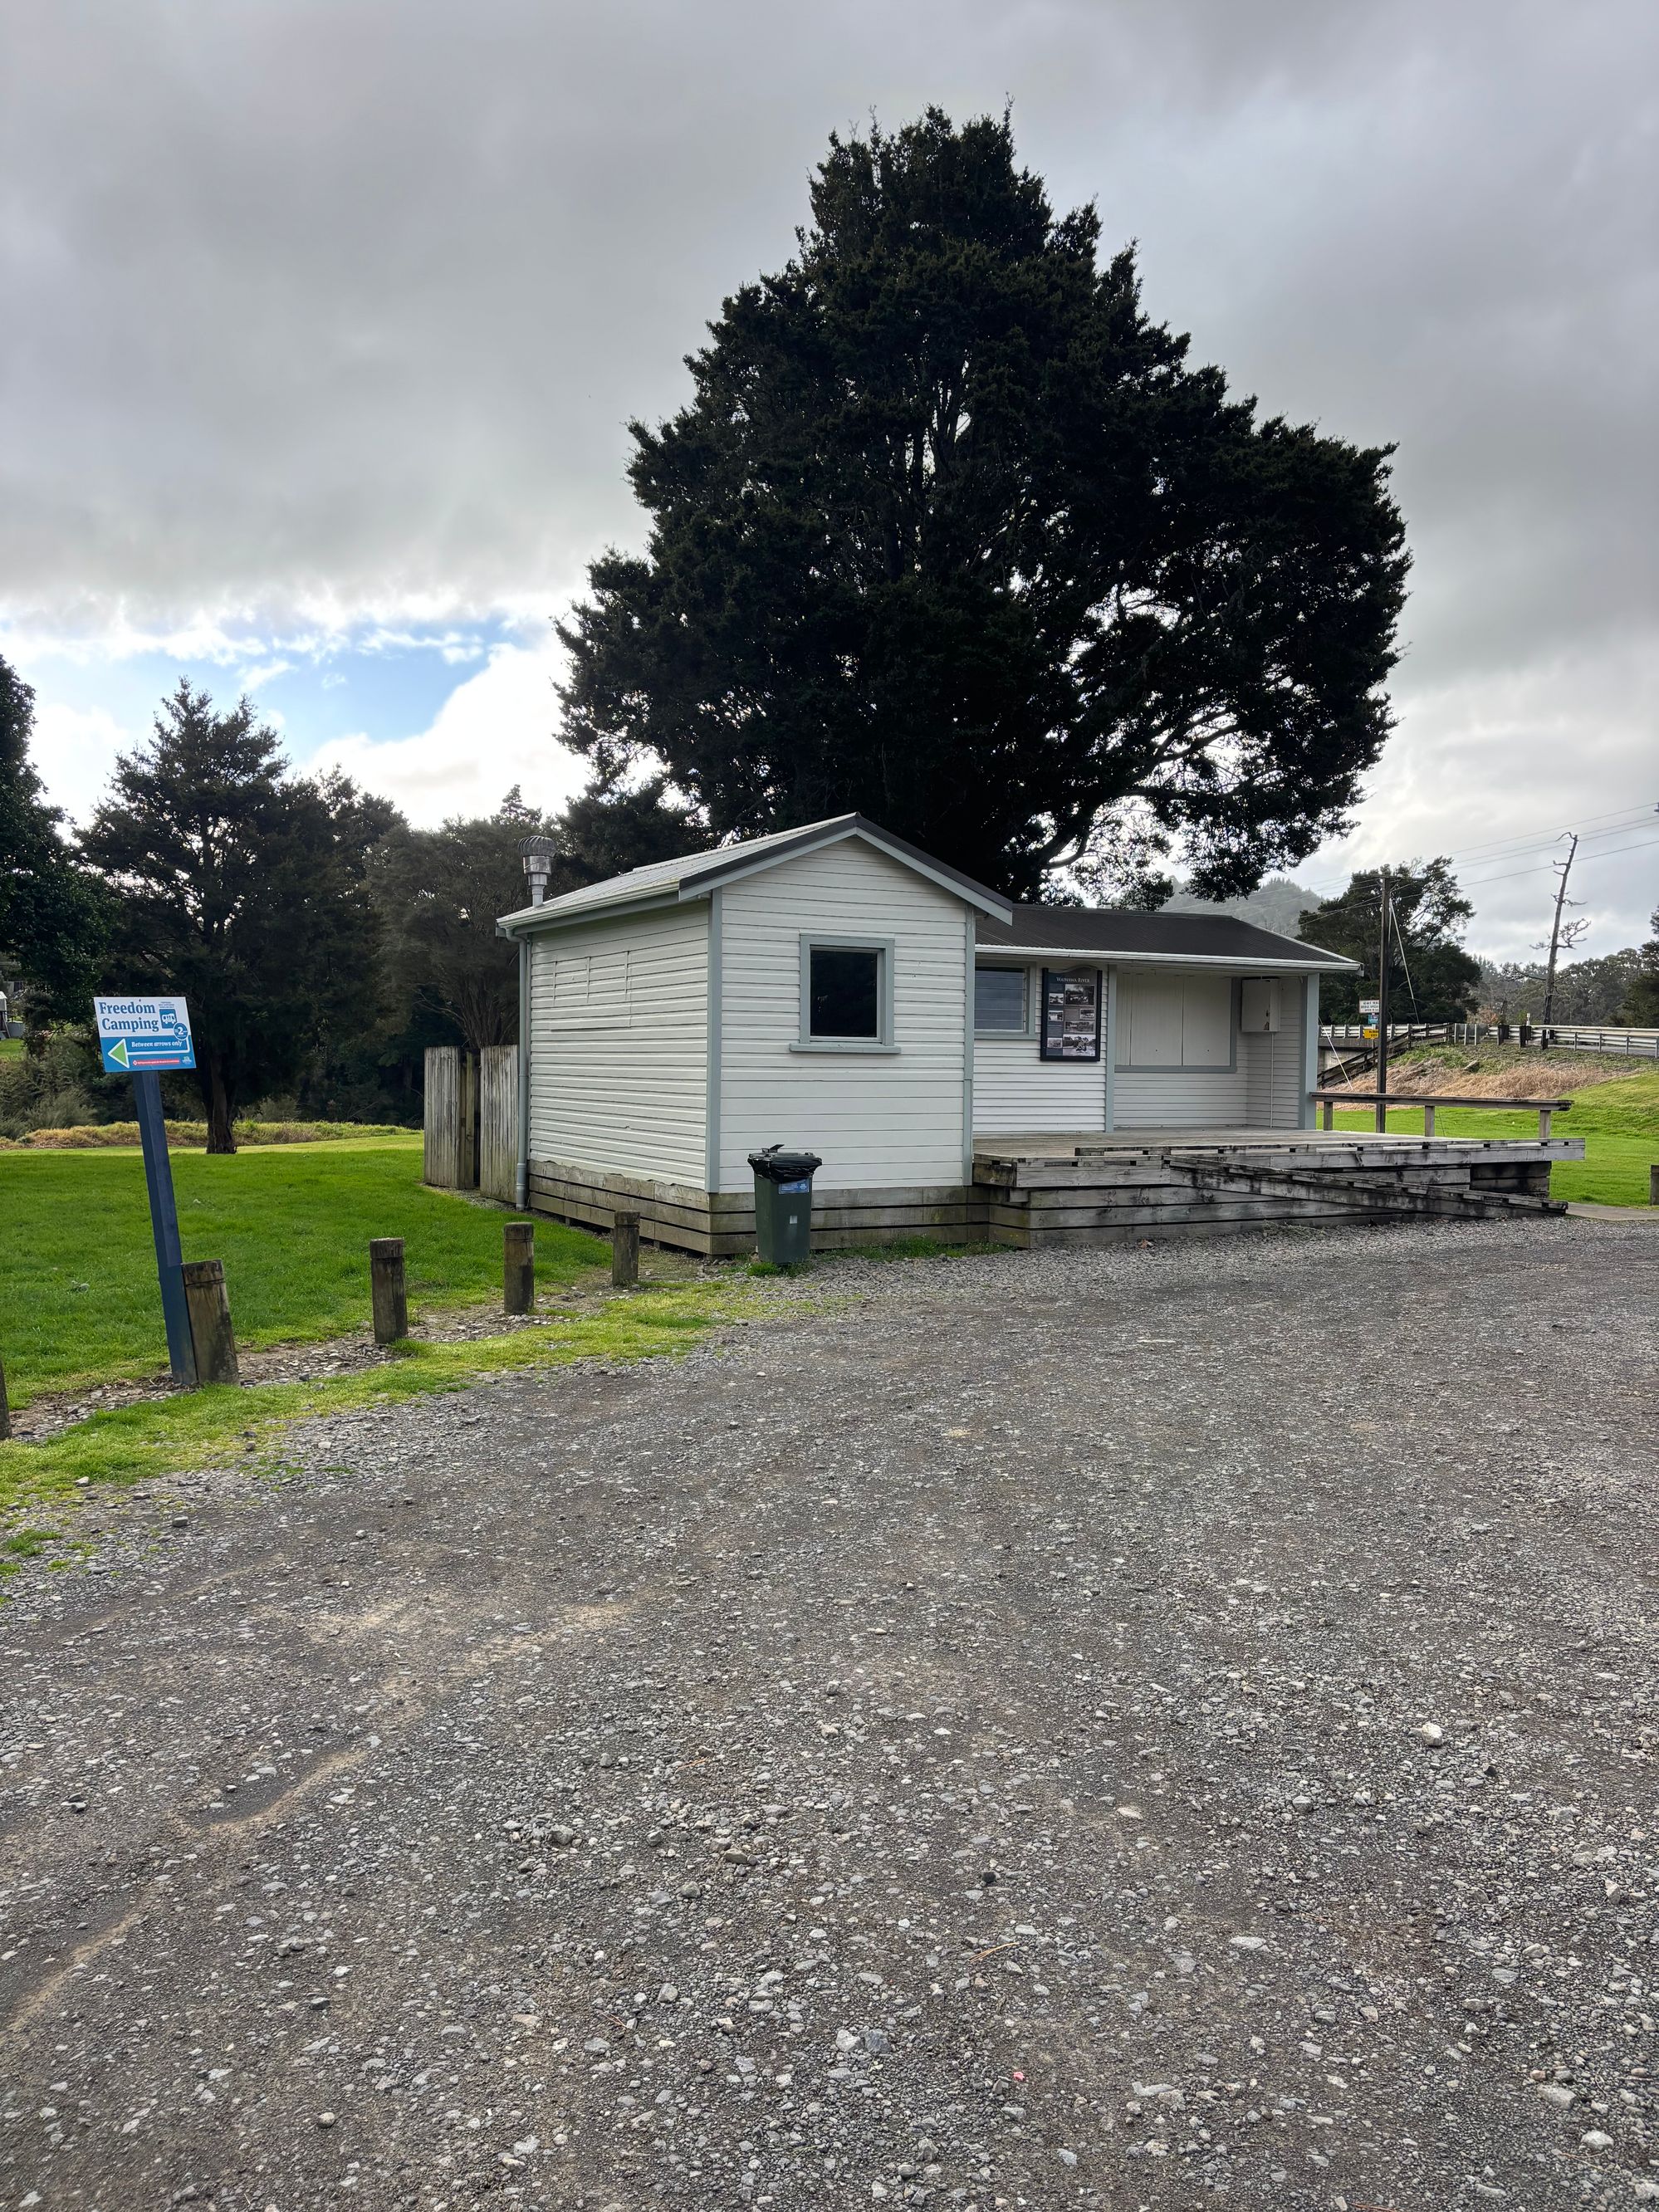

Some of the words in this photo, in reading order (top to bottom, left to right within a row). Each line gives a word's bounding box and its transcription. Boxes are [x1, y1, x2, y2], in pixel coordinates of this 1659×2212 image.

[98, 1001, 156, 1014] Freedom
[101, 1017, 159, 1032] Camping
[177, 1026, 184, 1035] 2
